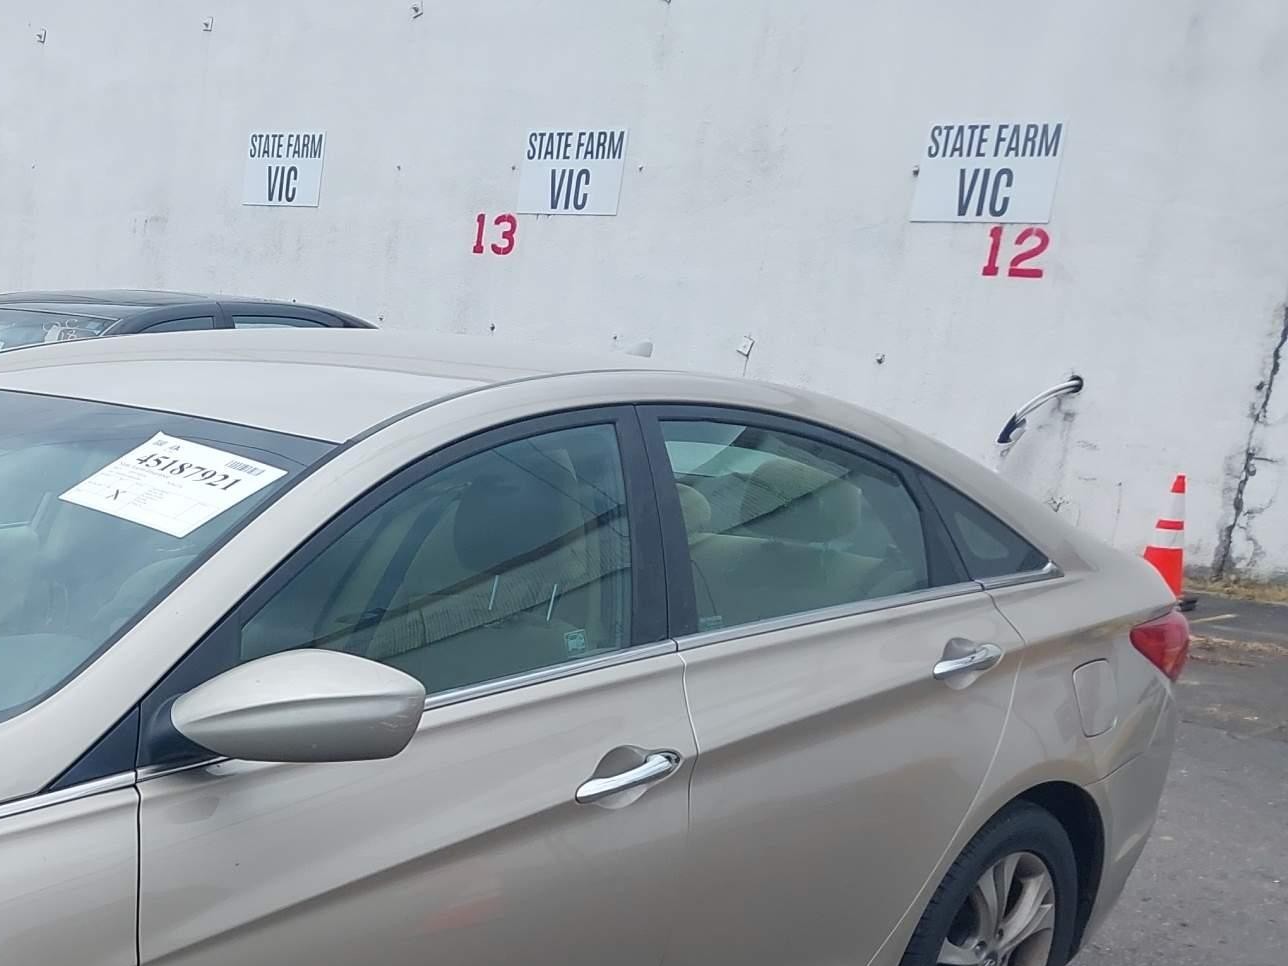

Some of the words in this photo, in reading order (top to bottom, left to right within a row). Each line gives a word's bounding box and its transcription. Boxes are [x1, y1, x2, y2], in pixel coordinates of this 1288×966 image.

[249, 133, 285, 159] STATE
[286, 133, 324, 159] FARM
[526, 130, 574, 161] STATE
[576, 130, 625, 161] FARM
[927, 124, 991, 159] STATE
[993, 122, 1063, 159] FARM
[267, 165, 298, 203] VIC
[550, 168, 591, 211] VIC
[957, 167, 1014, 218] VIC
[472, 211, 519, 257] 13
[981, 225, 1051, 279] 12
[135, 451, 243, 492] 45187921
